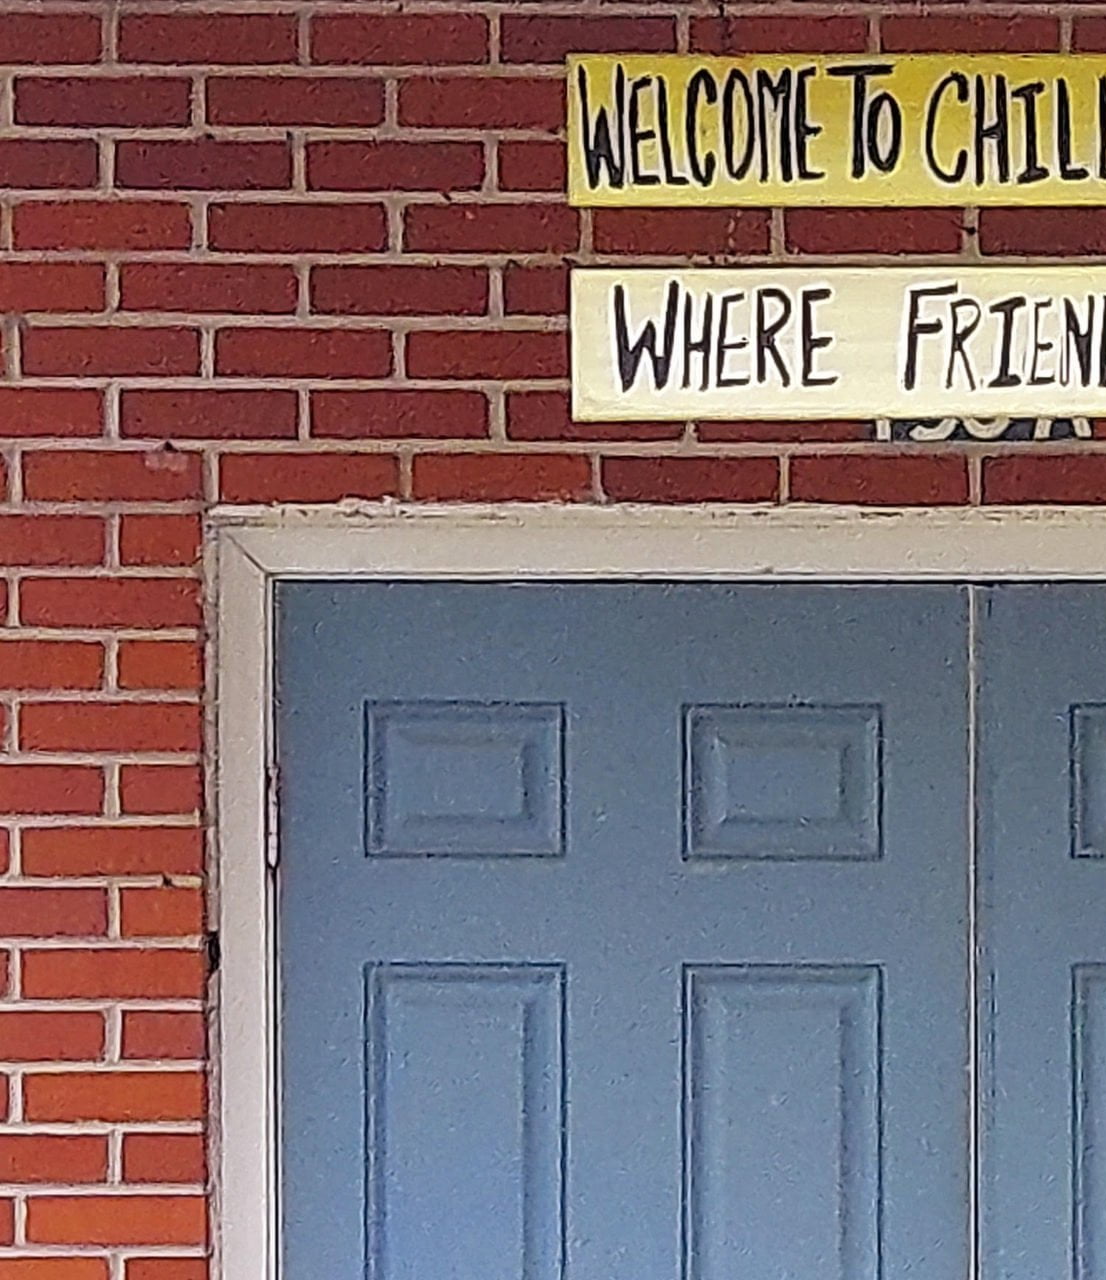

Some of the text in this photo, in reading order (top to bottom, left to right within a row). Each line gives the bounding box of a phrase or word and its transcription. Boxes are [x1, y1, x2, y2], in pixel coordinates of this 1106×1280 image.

[577, 63, 825, 189] WELCOME
[826, 63, 901, 179] TO
[613, 280, 839, 393] WHERE
